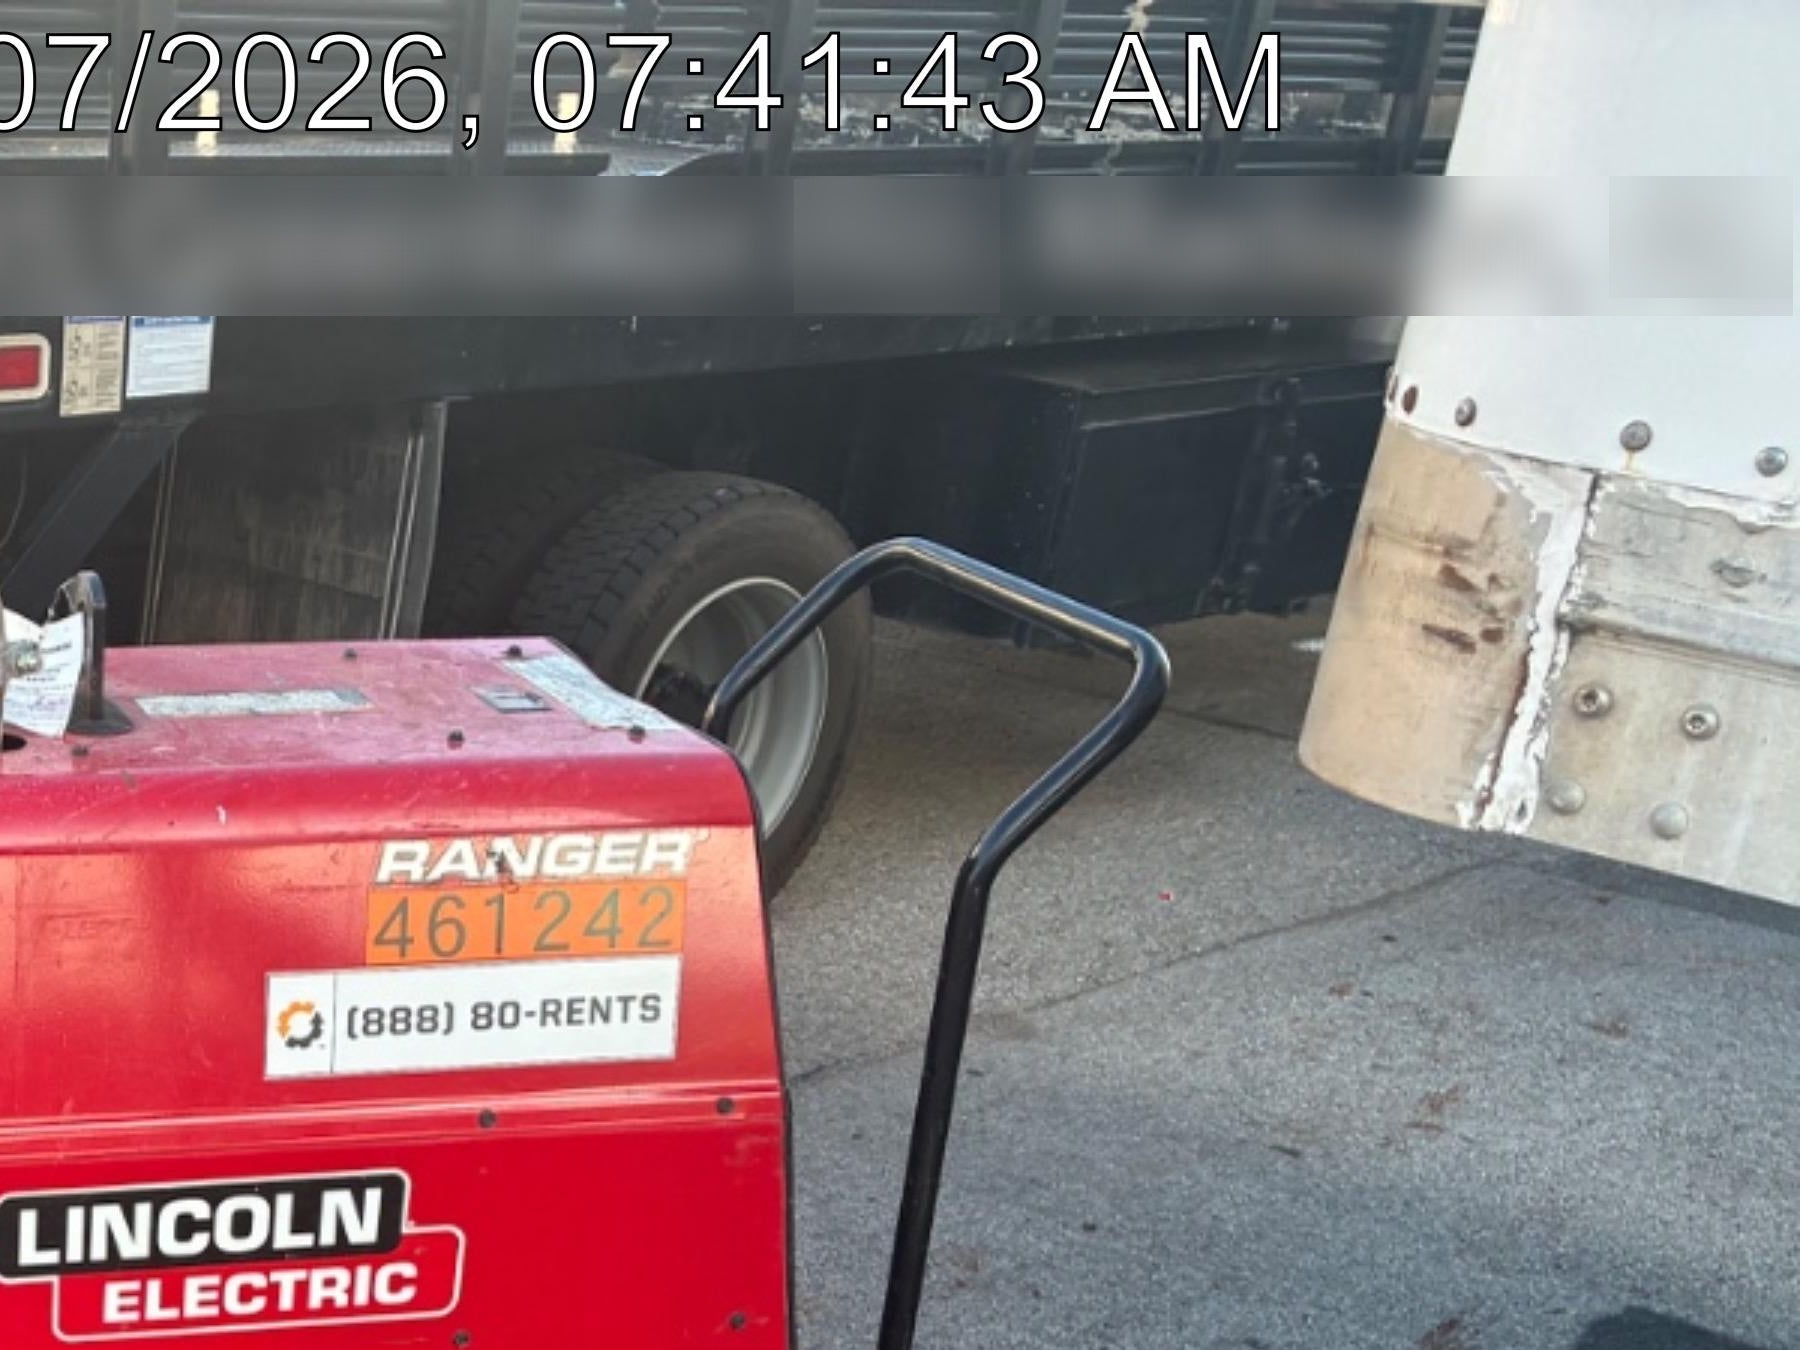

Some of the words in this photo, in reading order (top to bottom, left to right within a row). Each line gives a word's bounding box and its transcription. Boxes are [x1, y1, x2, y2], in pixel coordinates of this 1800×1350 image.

[375, 831, 692, 883] RANGER
[373, 885, 675, 959] 461242
[347, 1001, 455, 1040] (888)
[469, 993, 662, 1031] 80-RENTS
[17, 1186, 382, 1267] LINCOLN
[102, 1262, 418, 1324] ELECTRIC
